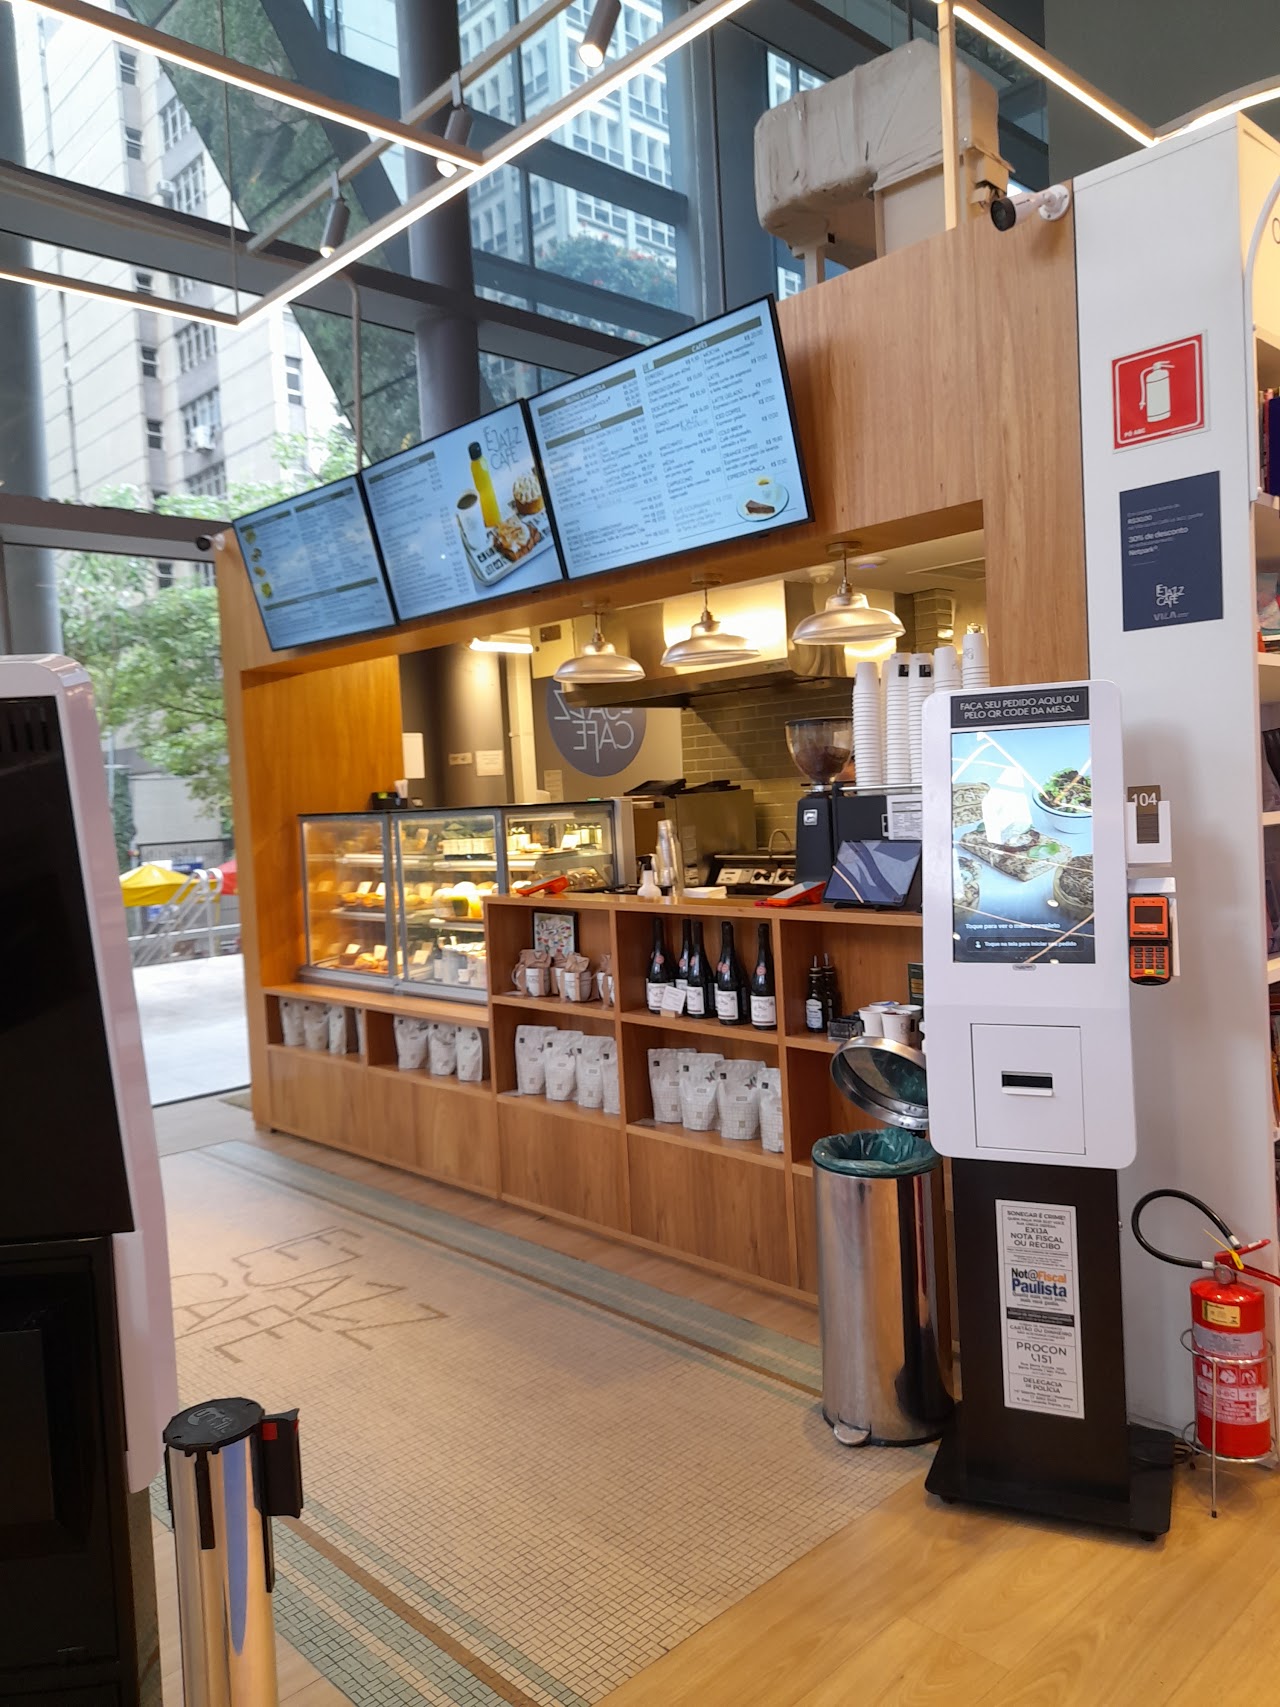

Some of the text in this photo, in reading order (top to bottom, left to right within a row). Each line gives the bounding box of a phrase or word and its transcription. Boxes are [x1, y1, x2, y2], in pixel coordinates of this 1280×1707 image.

[1154, 527, 1189, 538] desconto
[960, 695, 1079, 713] FAÇA SEU PEDIDO AQUI OU
[965, 710, 986, 719] PELO
[988, 710, 1002, 718] QR
[1003, 708, 1029, 717] CODE
[1031, 706, 1044, 715] DA
[1131, 793, 1158, 807] 104
[1006, 1210, 1037, 1218] SONEGAR
[1025, 1226, 1048, 1234] EXIJA
[1010, 1232, 1063, 1243] NOTA FISCAL
[1029, 1240, 1060, 1250] RECIBO
[1011, 1277, 1066, 1297] Paulista
[1016, 1341, 1066, 1356] PROCON
[1037, 1353, 1052, 1364] 151
[1023, 1376, 1062, 1388] DELEGACIA
[1032, 1384, 1060, 1393] POLÍCIA
